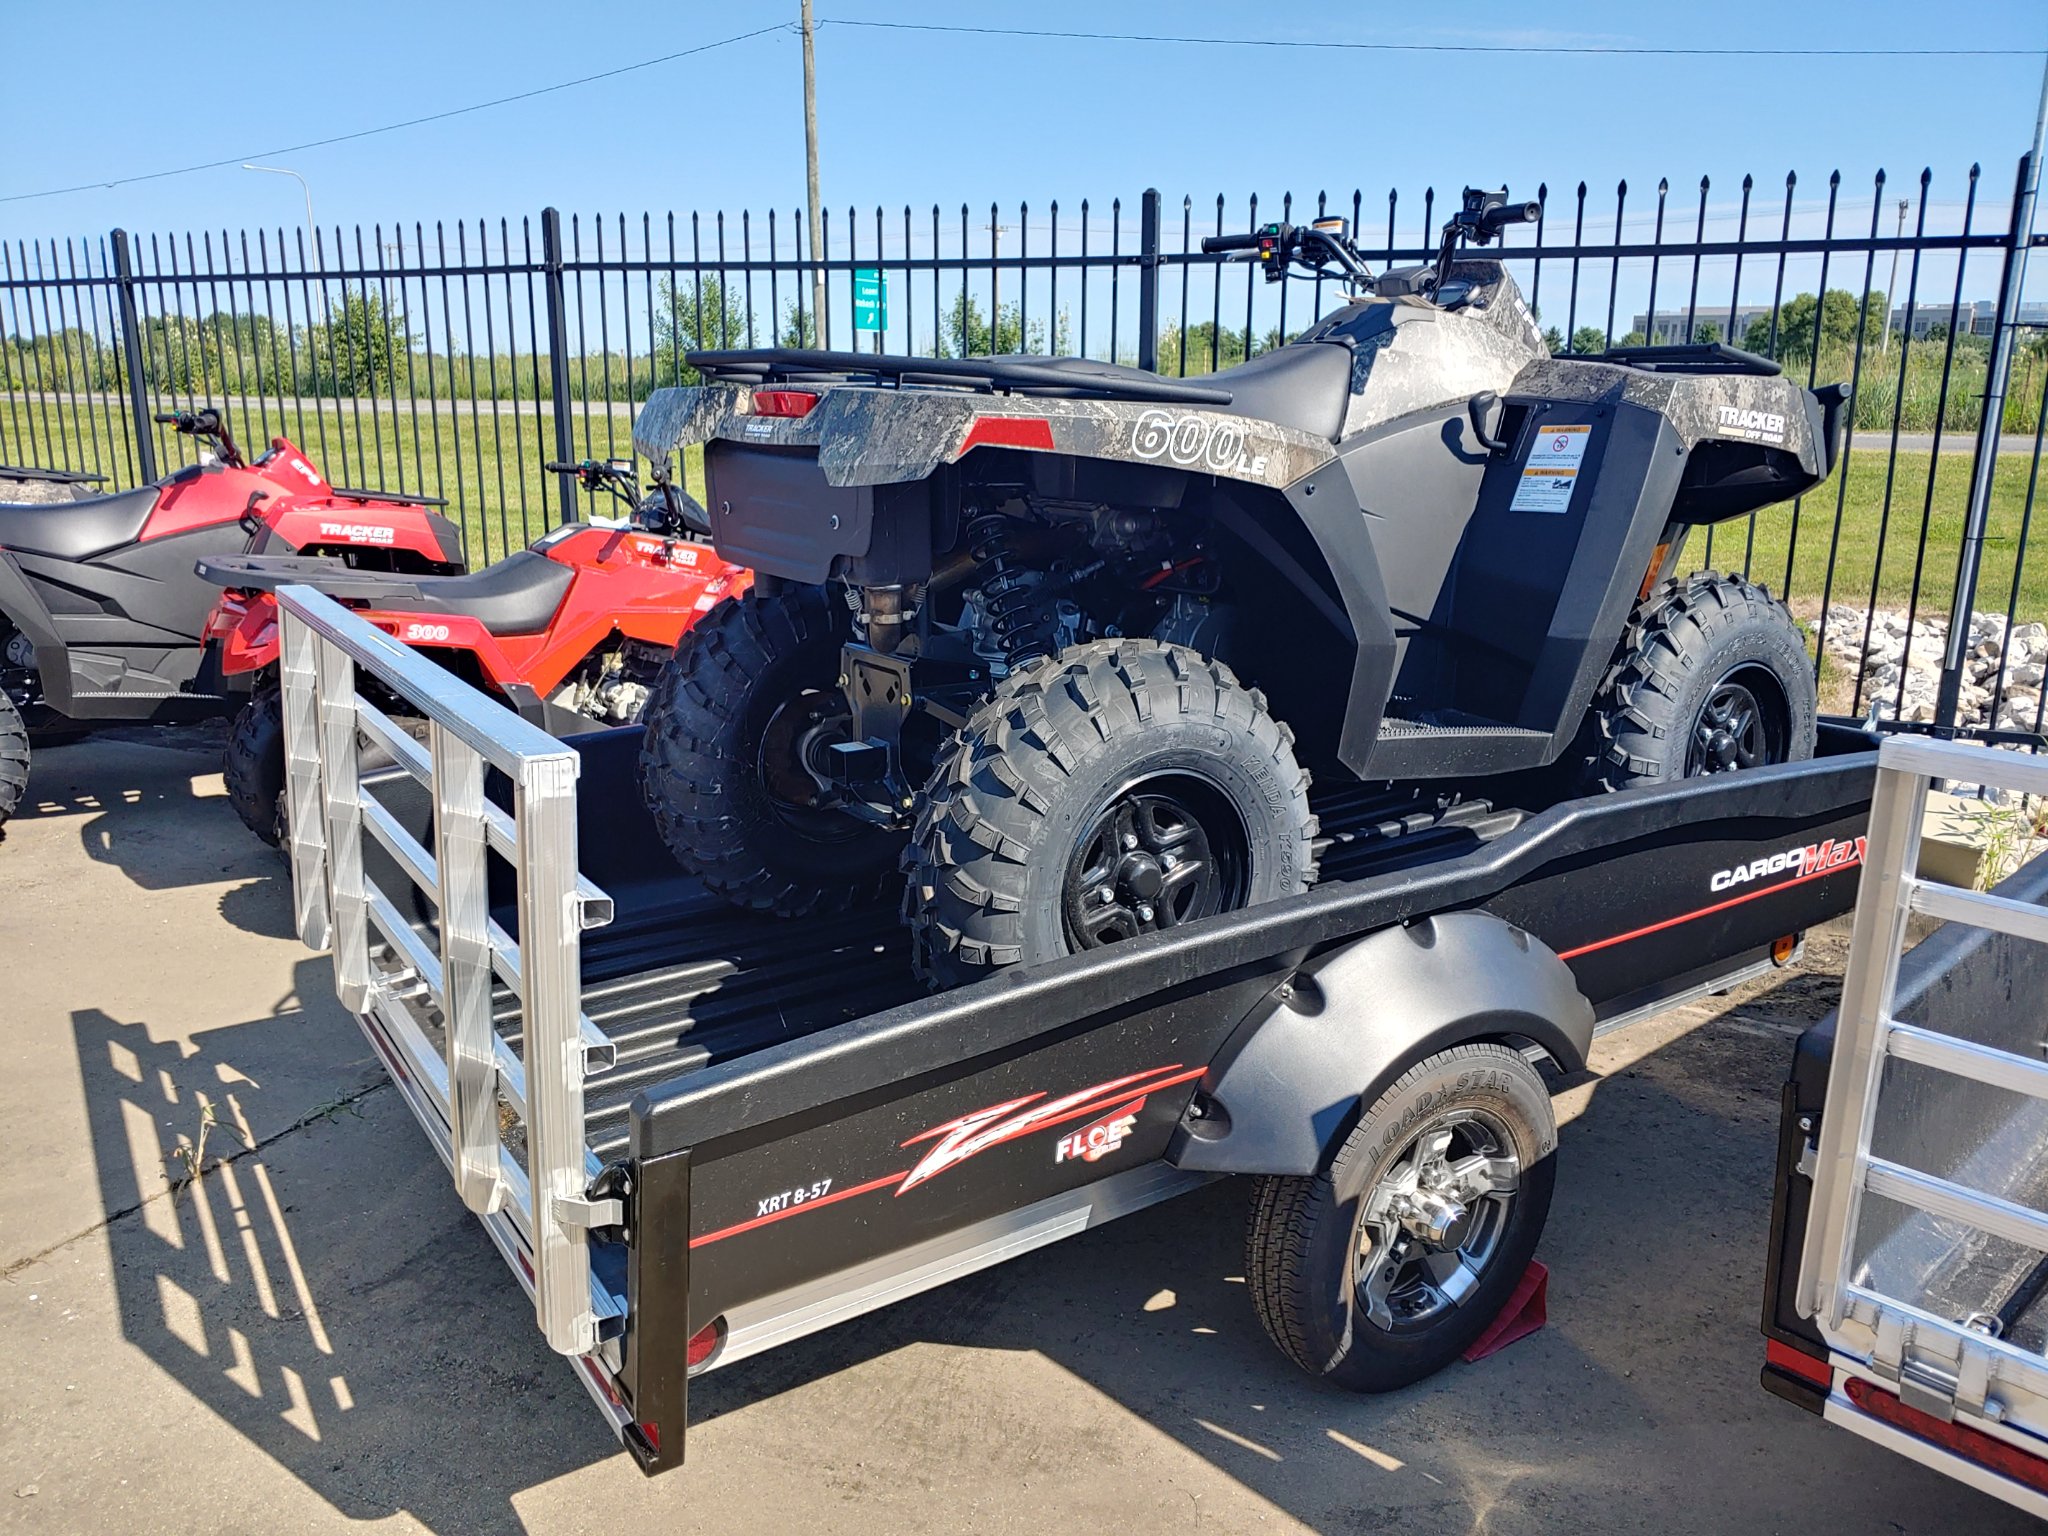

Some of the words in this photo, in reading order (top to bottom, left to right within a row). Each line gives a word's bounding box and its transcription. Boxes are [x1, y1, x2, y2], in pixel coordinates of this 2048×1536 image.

[1514, 298, 1541, 343] EPS
[746, 424, 773, 433] TRACKER
[1719, 406, 1785, 433] TRACKER
[1745, 430, 1762, 440] OFF
[1762, 432, 1784, 443] ROAD
[1132, 410, 1244, 470] 600
[1236, 454, 1268, 476] LE
[319, 523, 395, 539] TRACKER
[407, 623, 449, 641] 300
[1240, 755, 1287, 820] KENDA
[1279, 832, 1292, 891] K590
[1368, 1091, 1433, 1165] LOAD
[1453, 1069, 1514, 1094] STAR
[1055, 1116, 1125, 1164] FLOE
[757, 1191, 792, 1217] XRT
[793, 1178, 832, 1205] 8-57
